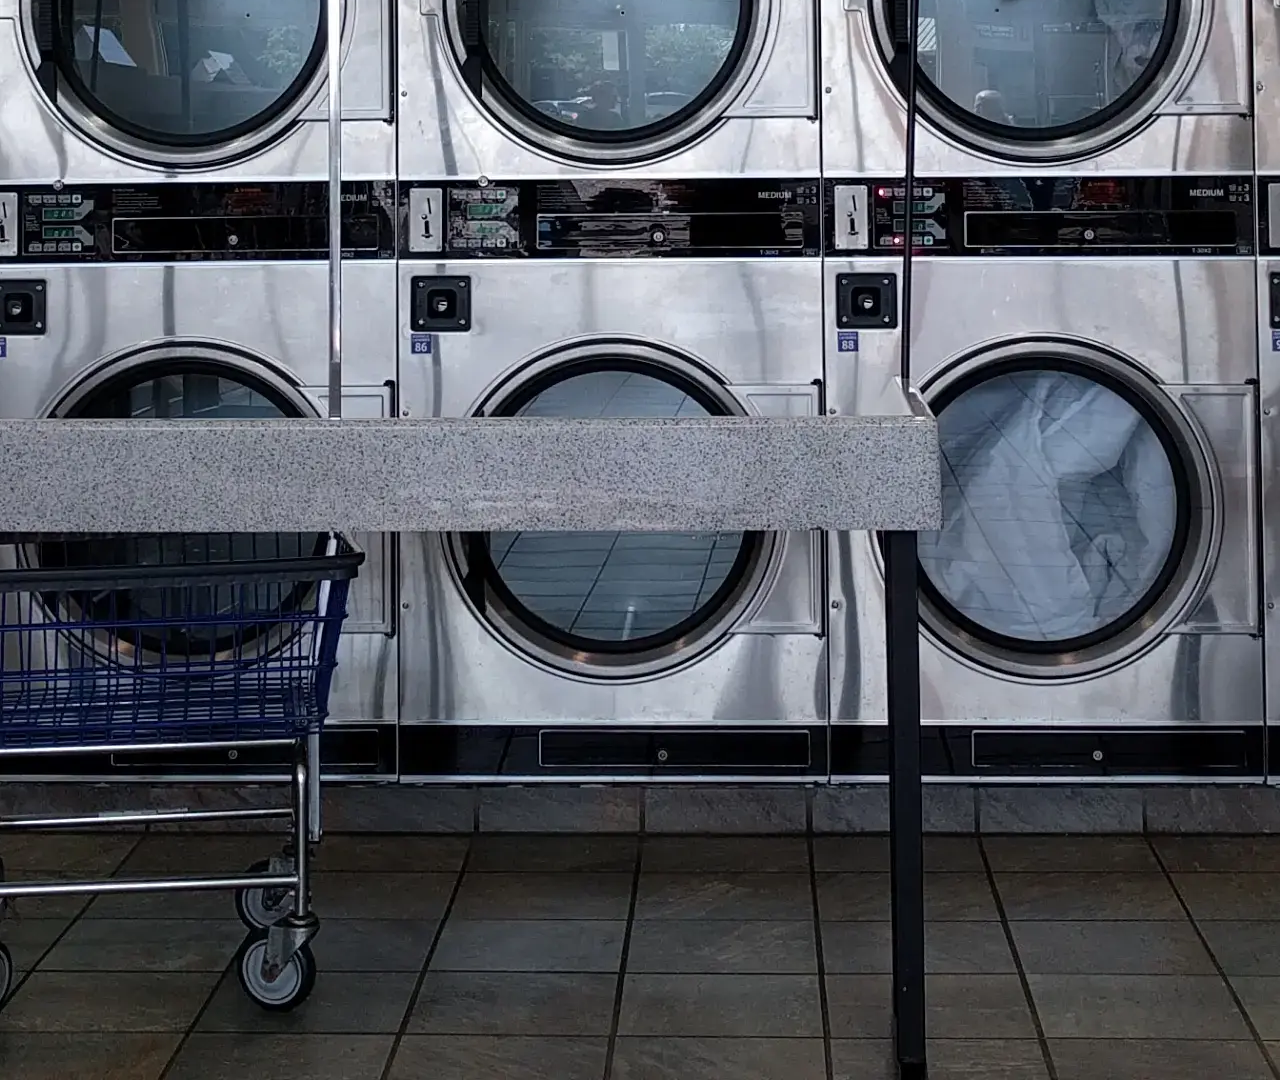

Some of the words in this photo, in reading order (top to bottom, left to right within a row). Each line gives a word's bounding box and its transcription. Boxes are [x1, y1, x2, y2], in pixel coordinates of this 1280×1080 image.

[757, 191, 792, 199] MEDIUM
[1189, 188, 1224, 197] MEDIUM
[340, 194, 368, 202] EDIUM
[415, 342, 427, 352] 86
